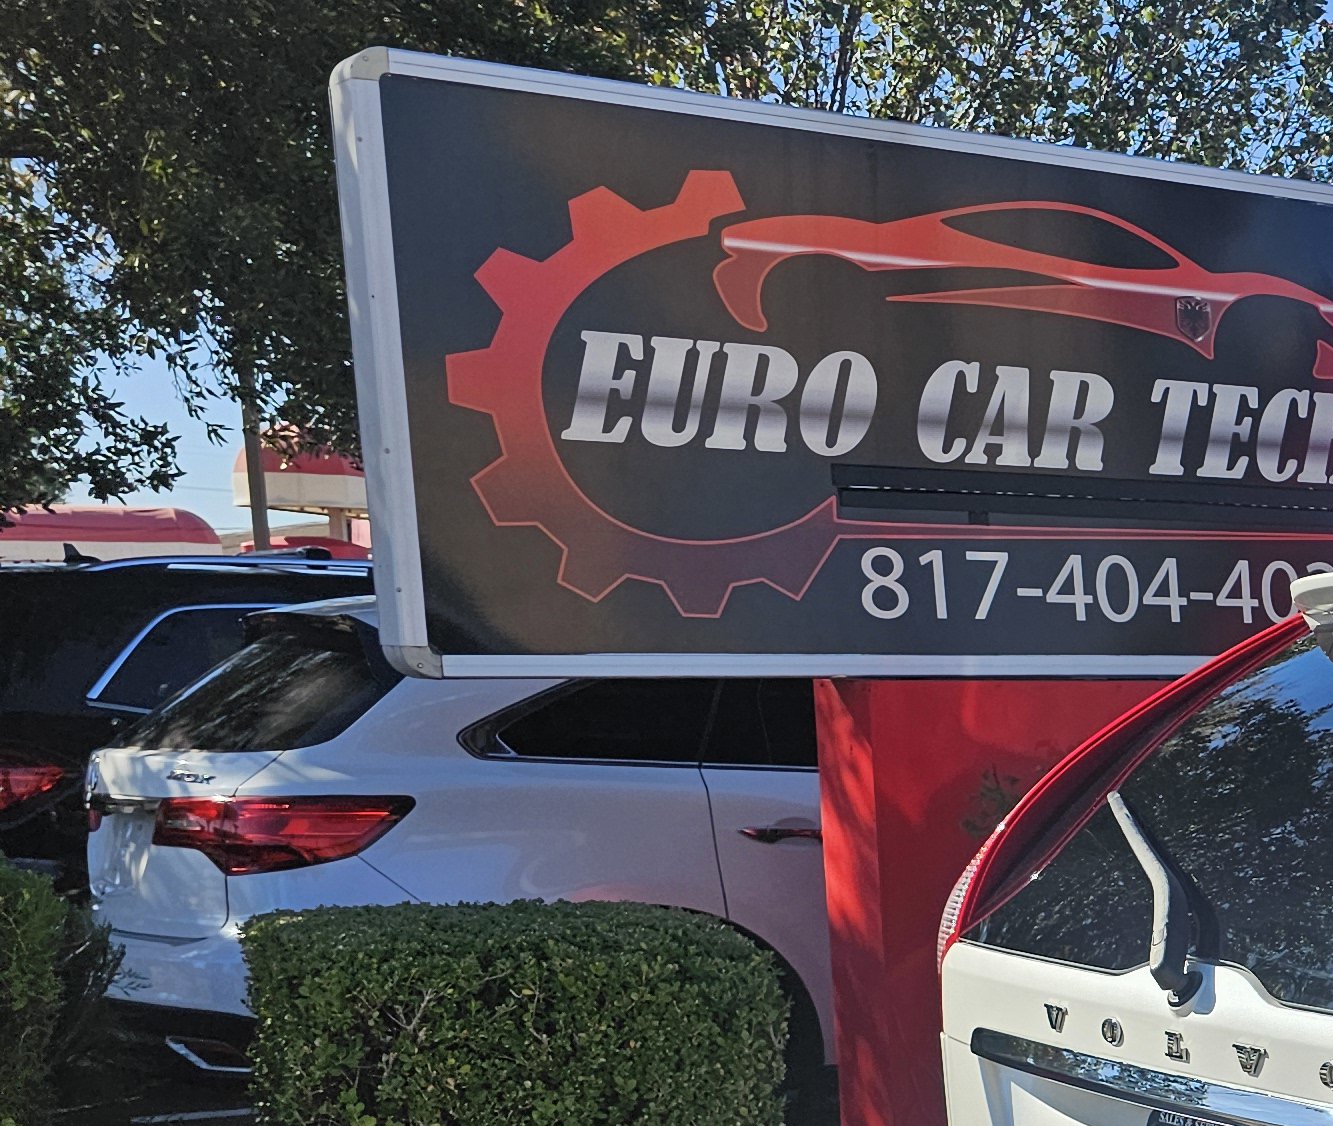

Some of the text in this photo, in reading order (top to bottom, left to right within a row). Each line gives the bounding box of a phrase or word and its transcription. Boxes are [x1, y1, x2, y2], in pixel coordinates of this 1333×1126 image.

[561, 329, 878, 456] EURO
[917, 359, 1114, 471] CAR
[1159, 1111, 1184, 1126] SALES
